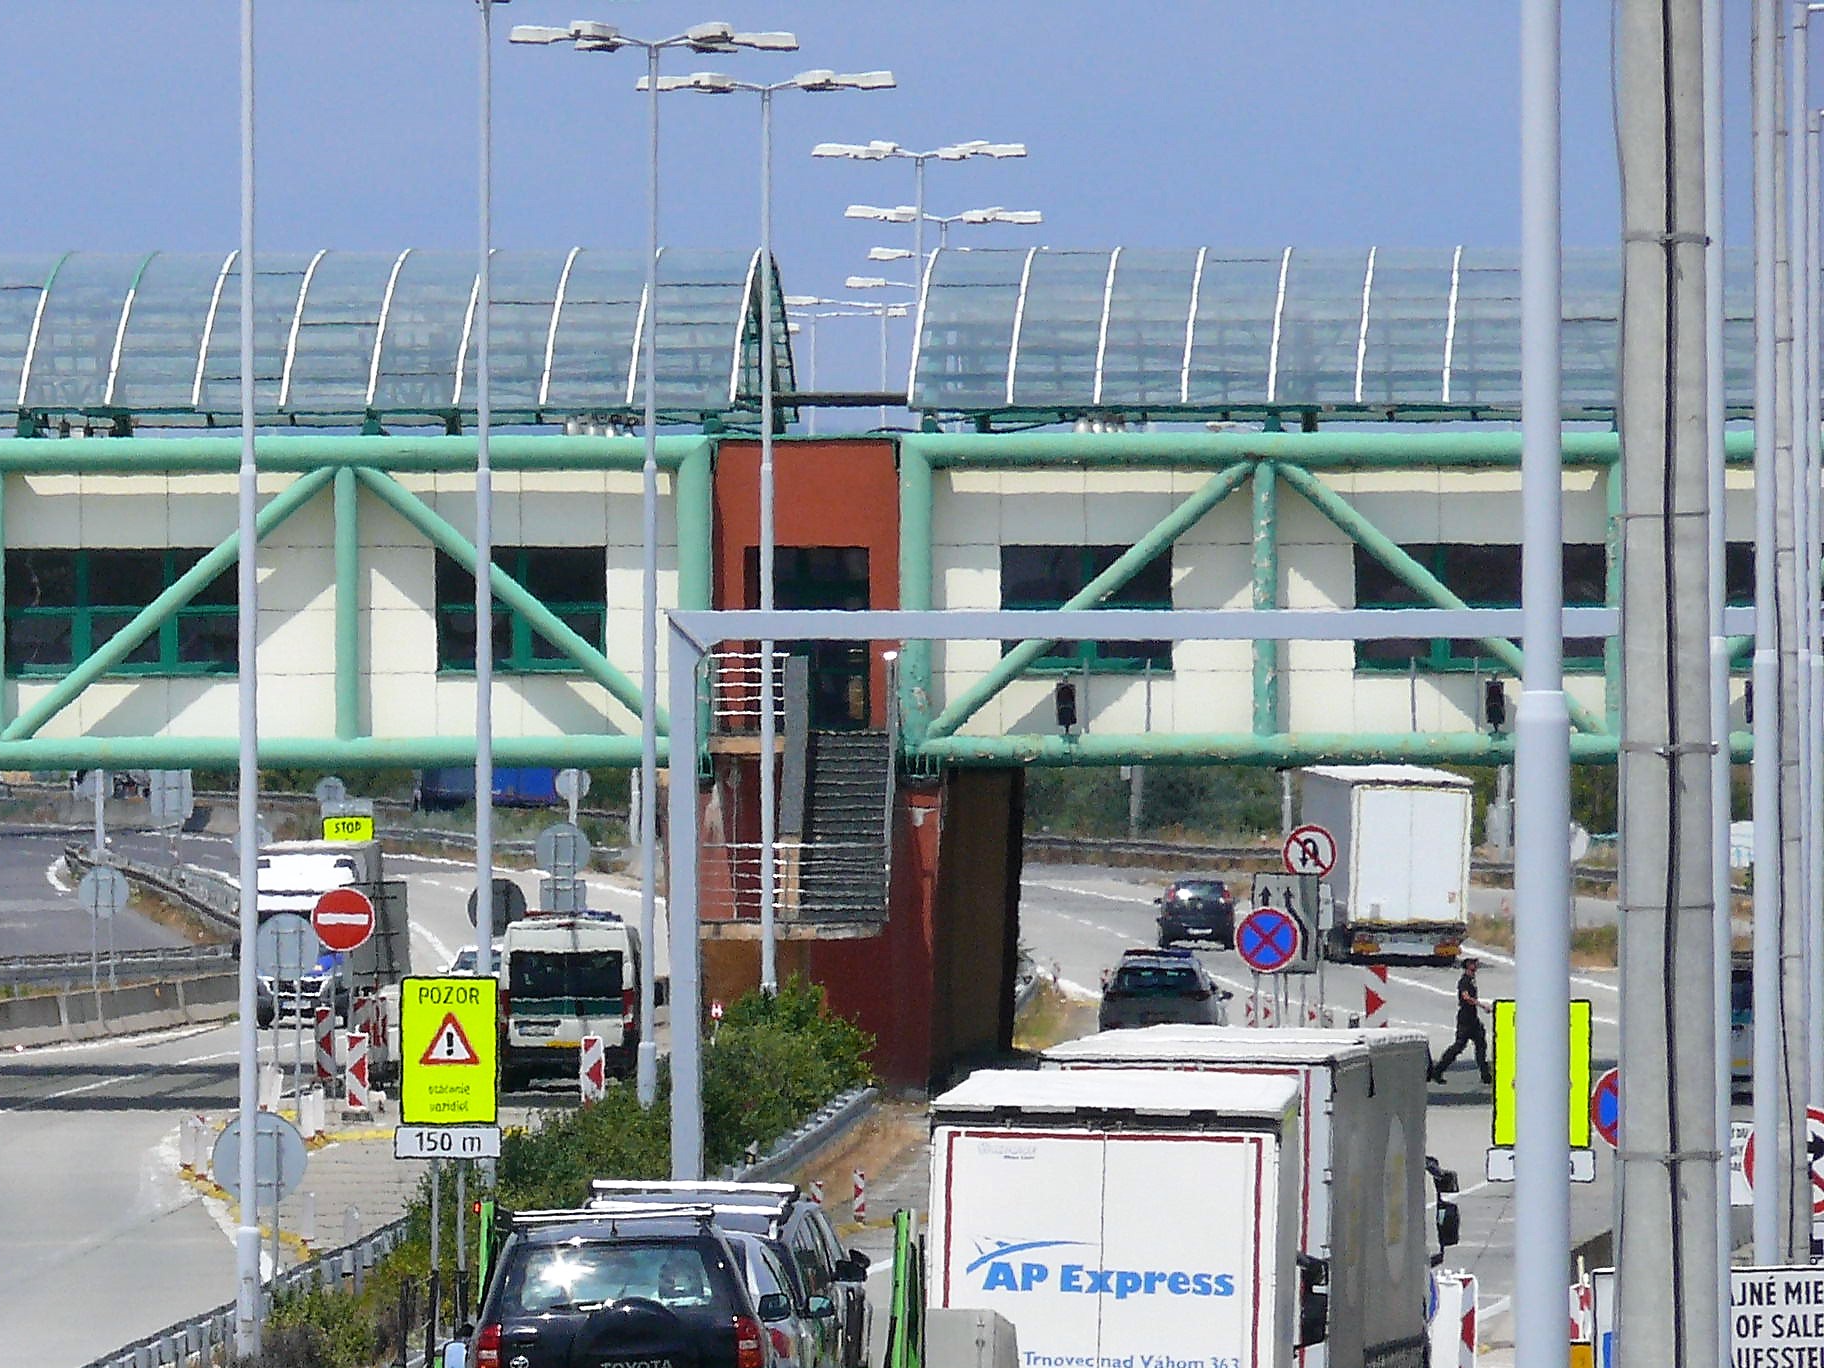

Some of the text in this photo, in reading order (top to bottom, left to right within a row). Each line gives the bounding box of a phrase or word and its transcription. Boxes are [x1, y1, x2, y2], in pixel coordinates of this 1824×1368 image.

[335, 821, 361, 833] STOP
[419, 986, 480, 1005] POZOR
[415, 1132, 481, 1152] 150 m
[982, 1261, 1234, 1299] AP Express
[1736, 1314, 1824, 1338] OF SALE
[1023, 1351, 1094, 1367] Trnovec
[1101, 1355, 1134, 1368] nad
